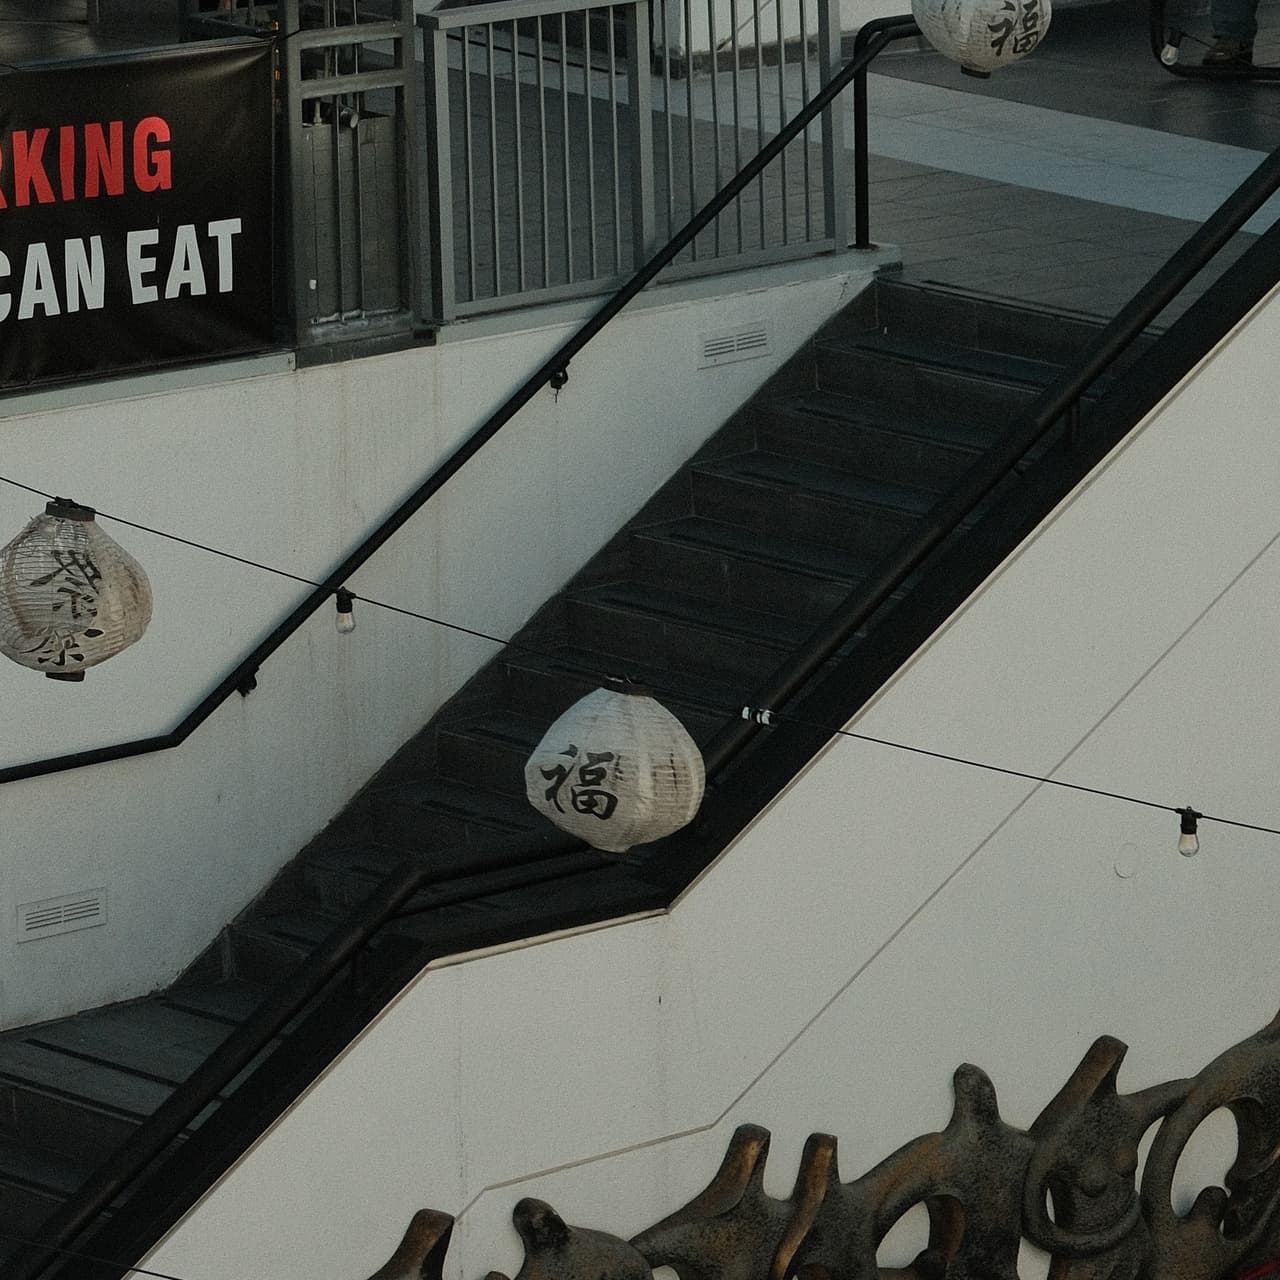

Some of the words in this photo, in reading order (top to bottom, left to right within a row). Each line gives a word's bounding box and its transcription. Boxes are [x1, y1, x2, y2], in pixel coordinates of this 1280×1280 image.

[0, 115, 173, 210] KING
[126, 217, 242, 305] EAT
[540, 744, 619, 820] 福
